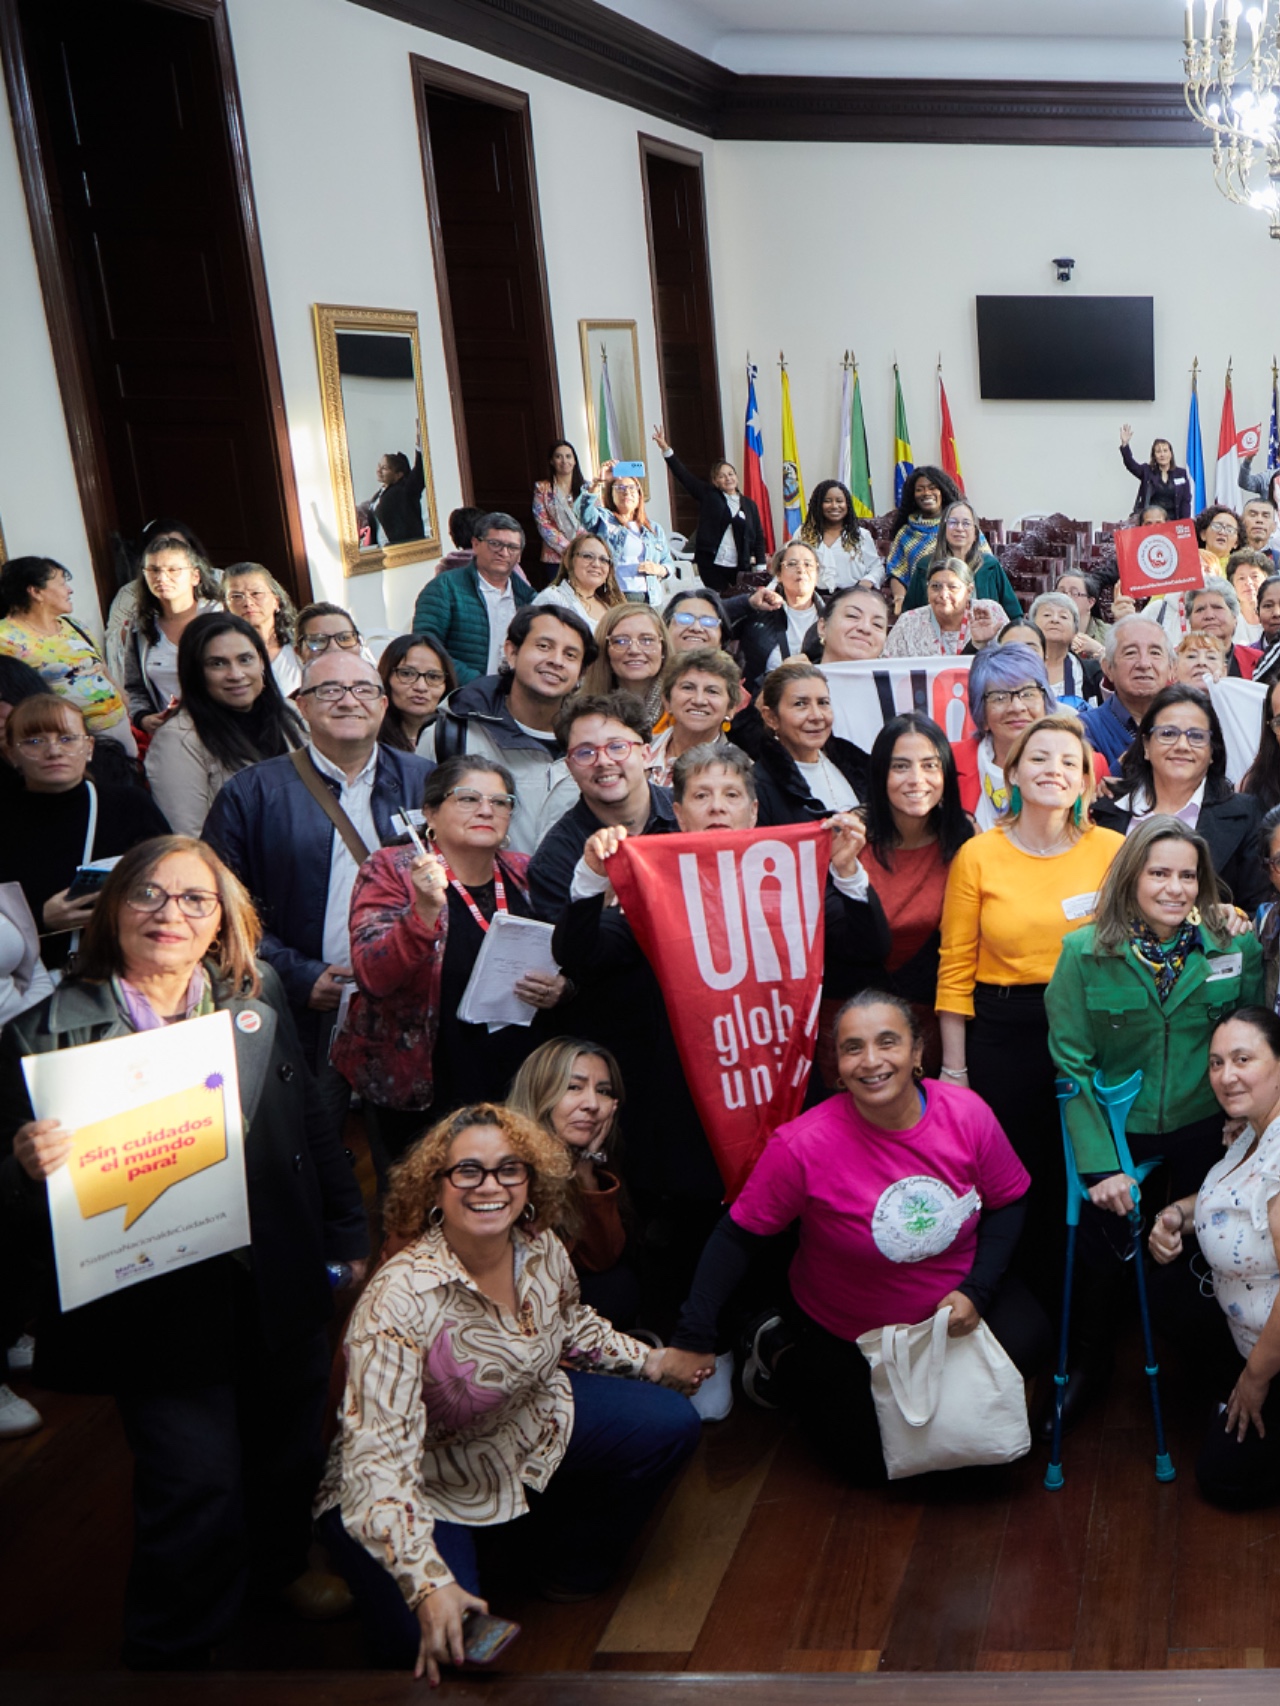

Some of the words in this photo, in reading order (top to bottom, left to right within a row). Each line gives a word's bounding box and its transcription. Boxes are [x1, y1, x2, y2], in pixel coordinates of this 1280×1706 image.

[713, 983, 823, 1066] globl
[79, 1146, 117, 1168] ¡Sin
[122, 1116, 213, 1151] cuidados
[100, 1157, 118, 1173] el
[124, 1135, 196, 1166] mundo
[127, 1153, 178, 1182] para!
